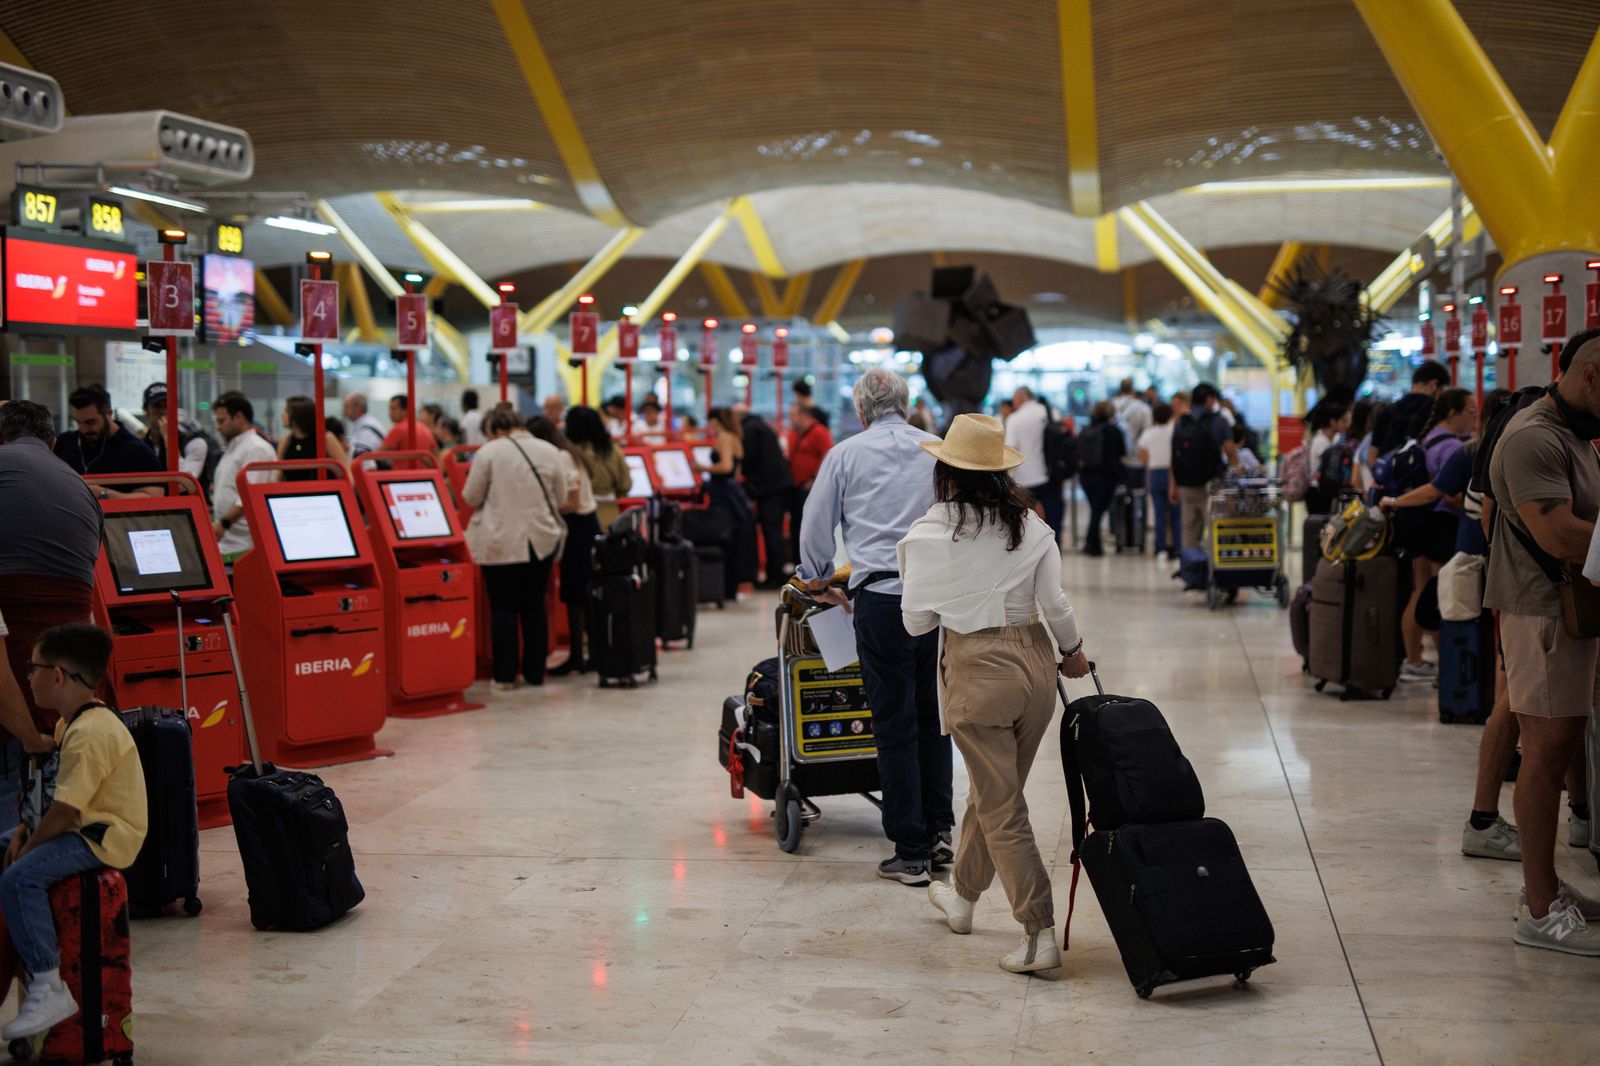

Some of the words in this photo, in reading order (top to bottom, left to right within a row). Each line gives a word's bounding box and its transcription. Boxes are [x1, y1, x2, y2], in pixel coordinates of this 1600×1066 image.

[25, 191, 57, 223] 857
[92, 203, 122, 234] 858
[164, 284, 180, 308] 3
[313, 300, 327, 321] 4
[1545, 308, 1564, 326] 17
[406, 311, 417, 331] 5
[500, 318, 511, 336] 6
[1502, 316, 1520, 332] 16
[580, 325, 590, 343] 7
[407, 621, 451, 638] IBERIA
[295, 656, 352, 676] IBERIA
